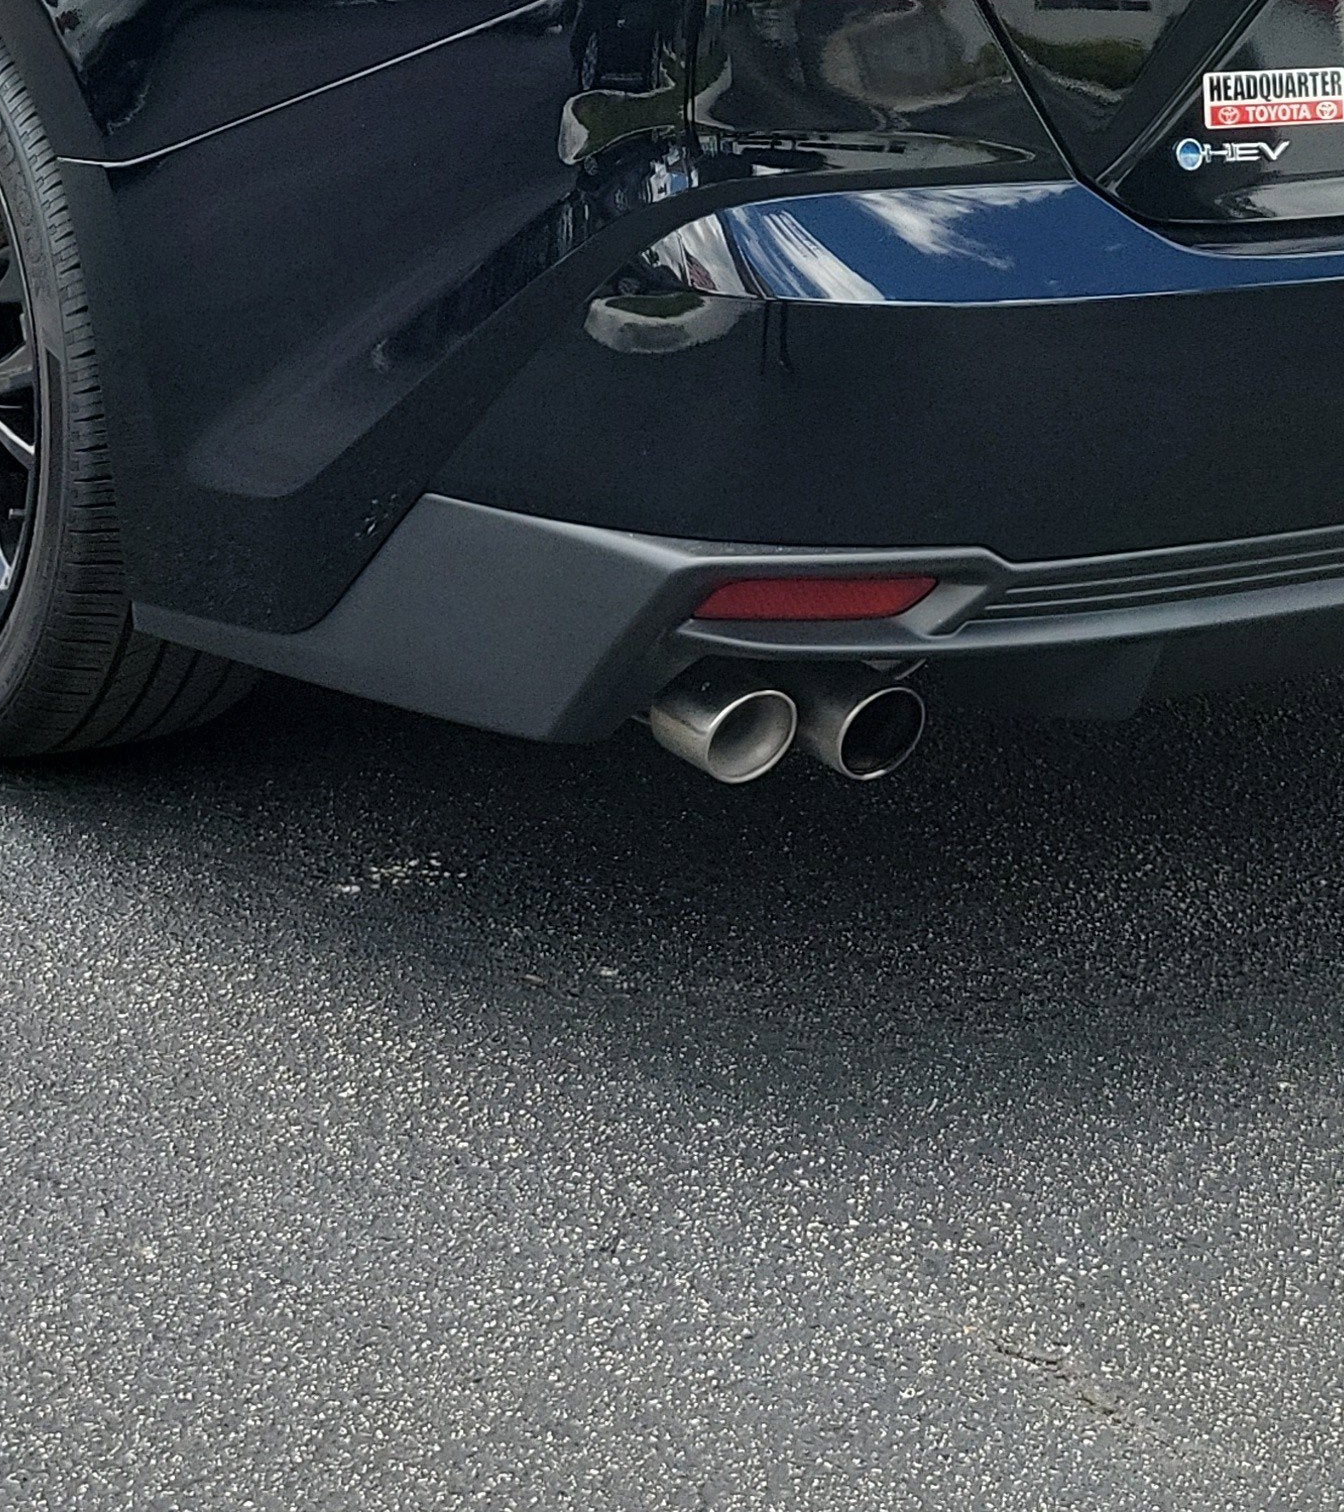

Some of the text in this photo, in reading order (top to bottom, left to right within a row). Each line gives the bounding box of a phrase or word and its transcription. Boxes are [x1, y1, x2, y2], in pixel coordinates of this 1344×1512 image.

[1209, 70, 1343, 102] HEADQUARTER
[1245, 104, 1312, 123] TOYOTA
[1205, 140, 1290, 164] HEV
